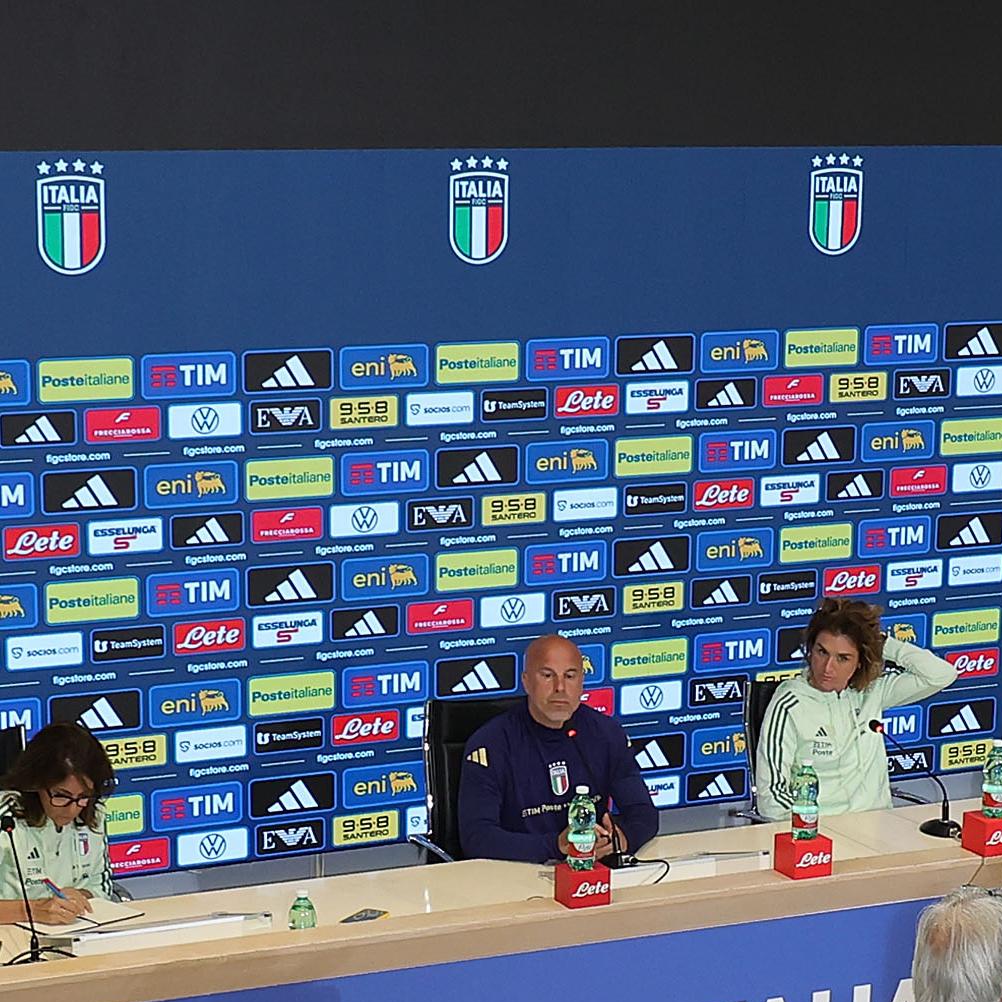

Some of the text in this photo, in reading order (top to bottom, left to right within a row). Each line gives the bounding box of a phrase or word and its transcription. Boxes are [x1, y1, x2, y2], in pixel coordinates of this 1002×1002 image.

[455, 181, 502, 197] ITALIA
[816, 177, 857, 192] ITALIA
[43, 185, 98, 203] ITALIA
[895, 334, 930, 354] TIM
[560, 348, 601, 369] TIM
[711, 343, 740, 361] eni
[351, 359, 384, 377] eni
[179, 364, 226, 386] TIM
[631, 388, 683, 397] ESSELUNGA
[838, 390, 878, 398] SANTERO
[498, 399, 545, 412] TeamSystem
[558, 391, 614, 413] Lete
[787, 411, 836, 421] figcstore.com
[896, 405, 944, 415] figcstore.com
[340, 414, 388, 425] SANTERO
[676, 417, 728, 429] figcstore.com
[560, 423, 614, 434] figcstore.com
[440, 430, 496, 442] figcstore.com
[871, 432, 899, 450] eni
[315, 437, 373, 449] figcstore.com
[183, 444, 245, 456] figcstore.com
[731, 440, 768, 460] TIM
[46, 451, 110, 464] figcstore.com
[536, 452, 567, 471] eni
[377, 460, 420, 483] TIM
[156, 474, 192, 495] eni
[765, 480, 814, 490] ESSELUNGA
[640, 493, 684, 505] TeamSystem
[696, 484, 749, 506] Lete
[893, 501, 940, 512] figcstore.com
[491, 512, 536, 522] SANTERO
[784, 509, 833, 520] figcstore.com
[674, 517, 725, 529] figcstore.com
[94, 525, 156, 536] ESSELUNGA
[559, 525, 613, 537] figcstore.com
[888, 526, 923, 546] TIM
[7, 531, 74, 556] Lete
[440, 534, 495, 546] figcstore.com
[316, 543, 374, 555] figcstore.com
[707, 542, 735, 559] eni
[185, 553, 246, 565] figcstore.com
[558, 551, 598, 572] TIM
[49, 562, 113, 575] figcstore.com
[891, 566, 938, 576] ESSELUNGA
[353, 568, 385, 587] eni
[826, 571, 876, 592] Lete
[184, 579, 230, 602] TIM
[773, 581, 814, 591] TeamSystem
[632, 600, 675, 609] SANTERO
[889, 596, 936, 607] figcstore.com
[781, 608, 812, 618] figcstore
[258, 619, 317, 631] ESSELUNGA
[672, 616, 723, 628] figcstore.com
[110, 637, 162, 650] TeamSystem
[176, 626, 240, 649] Lete
[440, 637, 495, 649] figcstore.com
[317, 648, 374, 661] figcstore.com
[725, 639, 762, 660] TIM
[187, 660, 247, 673] figcstore.com
[954, 655, 994, 674] Lete
[53, 672, 116, 685] figcstore.com
[377, 672, 420, 694] TIM
[161, 694, 195, 714] eni
[0, 710, 31, 729] IM
[669, 711, 720, 724] figcstore.com
[335, 718, 394, 740] Lete
[881, 715, 915, 734] TIM
[272, 728, 321, 740] TeamSystem
[702, 736, 730, 754] eni
[317, 750, 374, 763] figcstore.com
[949, 756, 985, 765] SANTERO
[189, 763, 249, 777] figcstore.com
[354, 776, 386, 795] eni
[648, 783, 674, 791] LUNGA
[188, 792, 233, 816] TIM
[343, 829, 389, 840] SANTERO
[110, 857, 161, 868] RECCIAROSSA
[796, 853, 830, 867] Lete
[572, 881, 609, 897] Lete
